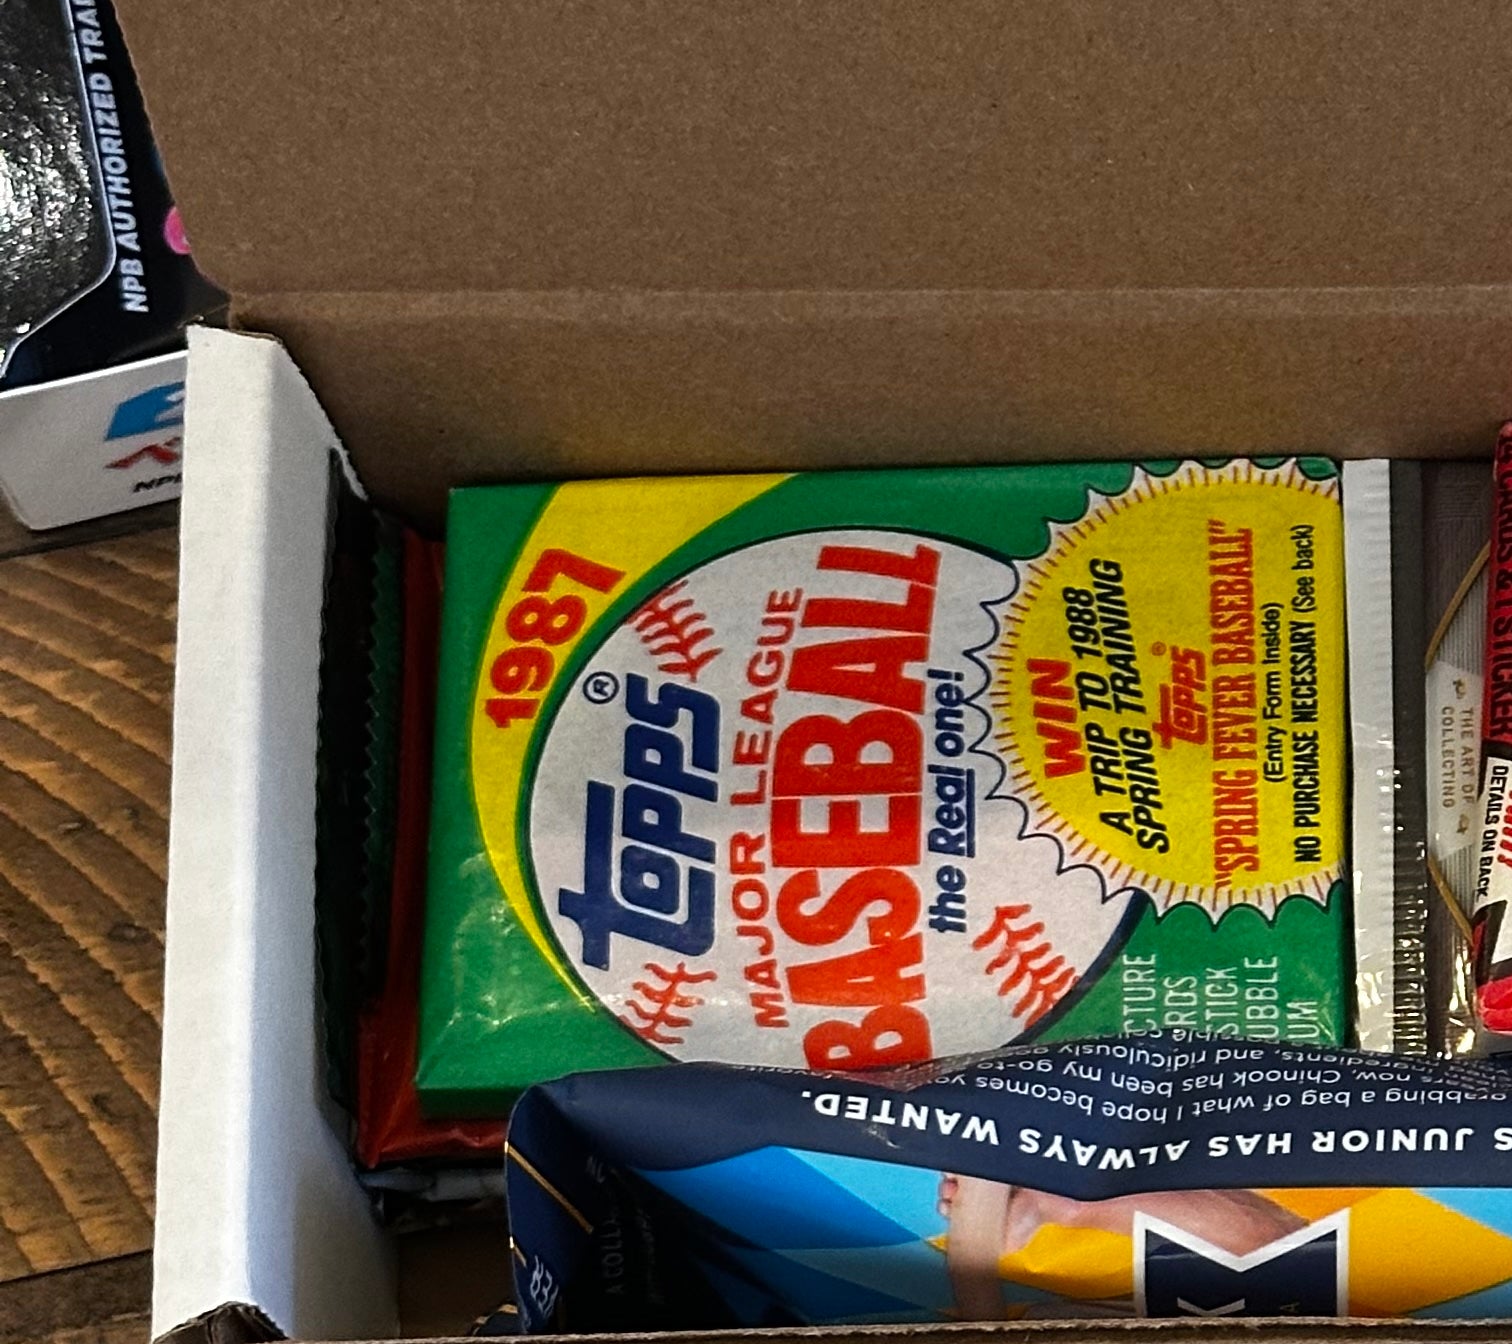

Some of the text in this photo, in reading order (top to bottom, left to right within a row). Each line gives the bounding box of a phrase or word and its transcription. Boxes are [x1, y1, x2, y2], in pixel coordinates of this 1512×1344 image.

[88, 69, 140, 256] AUTHORIZED
[119, 259, 150, 313] NPB
[482, 547, 628, 730] 1987
[1063, 586, 1133, 836] A TRIP TO 1988
[1089, 558, 1170, 855] SPRING TRAINING
[1259, 601, 1287, 783] (Entry Form Inside)
[1288, 523, 1324, 864] NO PURCHASE NECESSARY (See back)
[1026, 658, 1087, 780] WIN
[1211, 665, 1258, 768] FEVER
[1441, 706, 1456, 809] COLLECTING
[1460, 707, 1476, 804] THE ART OF
[729, 586, 803, 1028] MAJOR LEAGUE
[769, 544, 942, 1072] BASEBALL
[927, 668, 976, 935] the Real one!
[1473, 765, 1509, 898] DETAILS ON BACK
[1057, 1043, 1207, 1070] ridiculously
[1061, 1061, 1102, 1082] my
[1215, 1048, 1264, 1063] and
[1230, 1068, 1341, 1086] Chinook
[1351, 1068, 1412, 1083] now,
[974, 1074, 1094, 1116] becomes
[1110, 1069, 1174, 1099] been
[1181, 1072, 1225, 1092] has
[1192, 1094, 1256, 1115] what
[1261, 1093, 1292, 1112] of
[1301, 1089, 1350, 1107] bag
[1361, 1090, 1376, 1104] a
[800, 1088, 1000, 1146] WANTED.
[1101, 1100, 1168, 1123] hope
[1018, 1128, 1191, 1171] ALWAYS
[1207, 1131, 1293, 1158] HAS
[1311, 1127, 1475, 1153] JUNIOR
